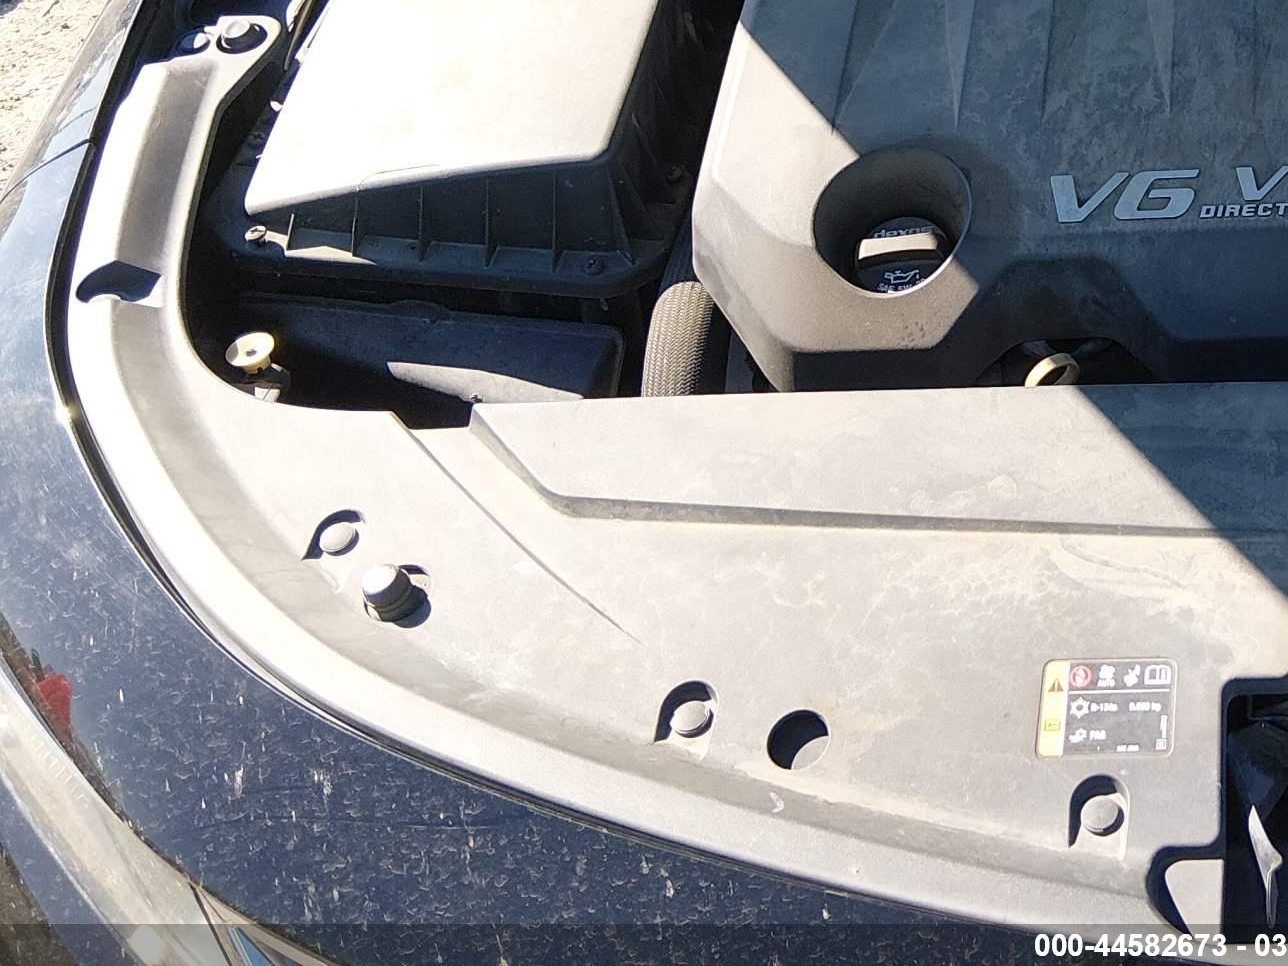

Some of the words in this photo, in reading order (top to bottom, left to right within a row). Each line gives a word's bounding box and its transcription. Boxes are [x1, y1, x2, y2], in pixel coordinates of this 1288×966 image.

[1050, 169, 1199, 224] V6
[1199, 202, 1288, 219] DIRECT
[1097, 679, 1116, 688] AUTO
